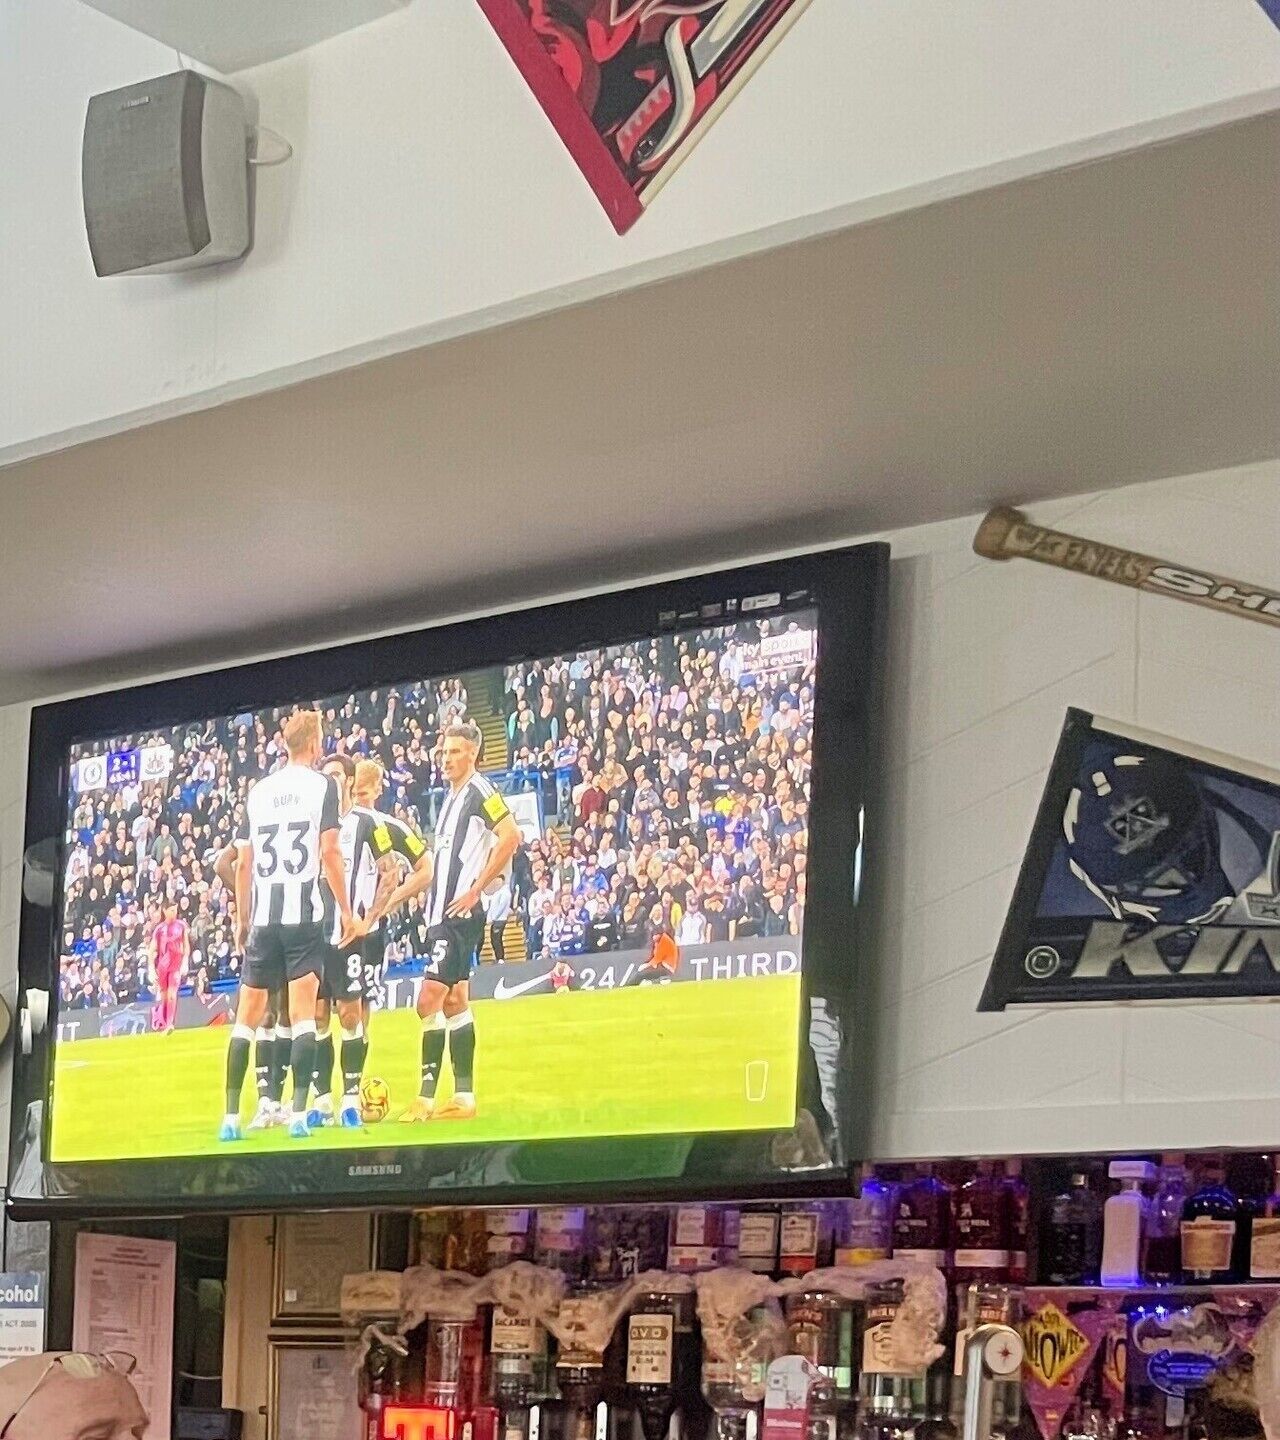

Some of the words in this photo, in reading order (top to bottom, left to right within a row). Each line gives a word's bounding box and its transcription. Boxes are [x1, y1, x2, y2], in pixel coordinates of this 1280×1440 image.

[256, 821, 310, 878] 33
[431, 940, 449, 962] 5
[347, 953, 362, 978] 8
[690, 950, 799, 982] THIRD
[348, 1164, 402, 1176] SAMSUNG
